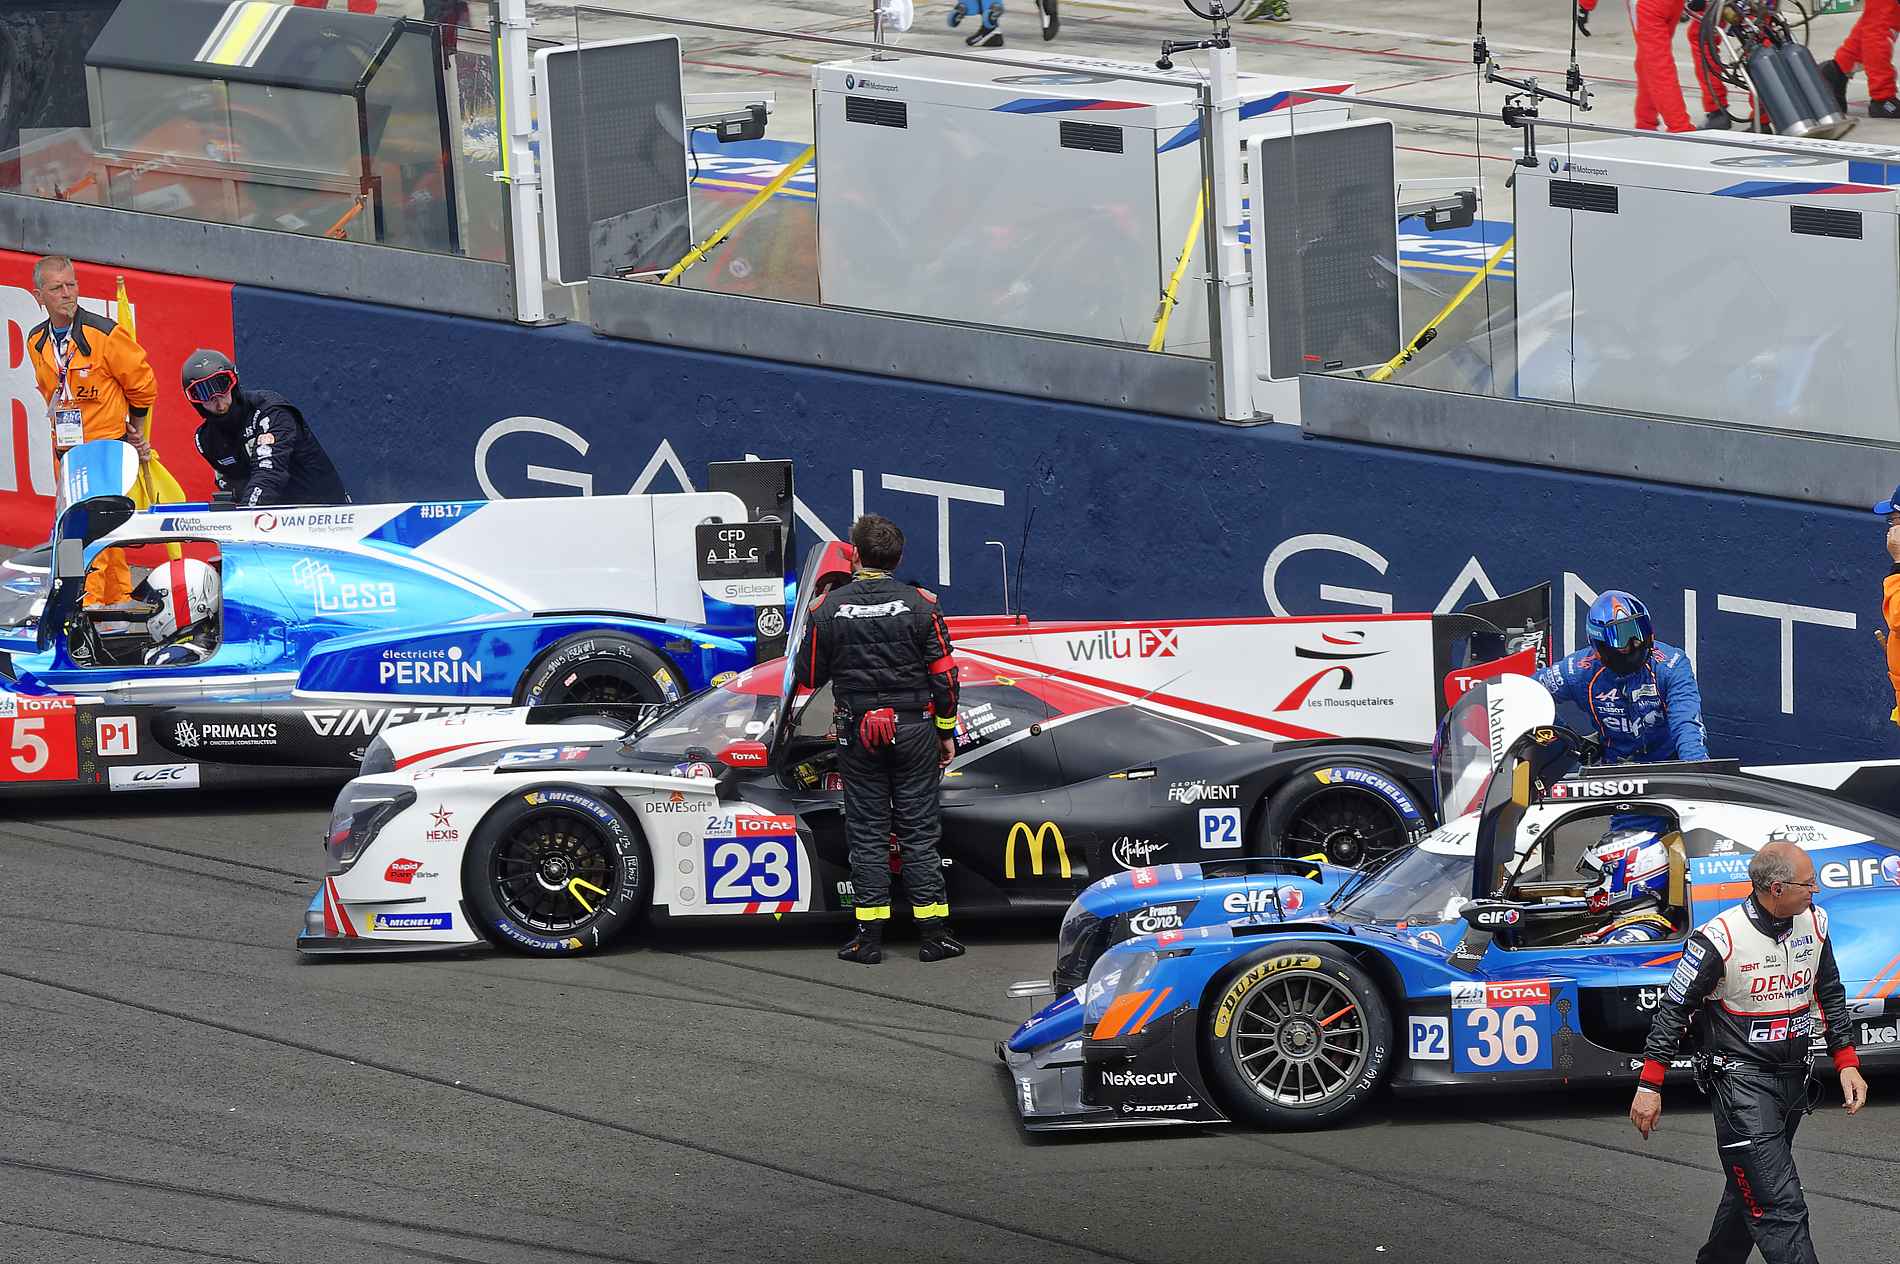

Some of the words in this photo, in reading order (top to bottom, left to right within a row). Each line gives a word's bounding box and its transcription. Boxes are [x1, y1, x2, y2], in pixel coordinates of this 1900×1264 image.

[870, 81, 899, 92] Motorsport
[1576, 165, 1609, 177] Motorsport
[420, 504, 463, 519] #JB17
[180, 517, 201, 526] Auto
[180, 523, 233, 532] Windscreens
[281, 514, 307, 528] VAN
[308, 513, 331, 527] DER
[334, 513, 355, 525] LEE
[718, 529, 746, 541] CFD
[725, 583, 777, 598] Silclear
[1139, 628, 1178, 658] FX
[382, 649, 445, 660] électricité
[379, 660, 482, 685] PERRIN
[22, 699, 73, 711] TOTAL
[1324, 696, 1395, 709] Mousquetaires
[100, 723, 130, 751] P1
[202, 723, 278, 739] PRIMALYS
[10, 718, 50, 774] 5
[730, 752, 762, 761] TOTAL
[132, 766, 188, 782] WEC
[1170, 779, 1207, 787] GROUPE
[1567, 779, 1649, 798] TISSOT
[1345, 769, 1415, 814] MICHELIN
[549, 791, 608, 818] MICHELIN
[738, 818, 797, 831] TOTAL
[1203, 815, 1237, 843] P2
[1785, 823, 1817, 832] France
[426, 829, 459, 840] HEXIS
[391, 863, 418, 871] Rapid
[712, 841, 792, 899] 23
[1819, 858, 1881, 889] elf
[1223, 889, 1275, 913] elf
[1149, 906, 1177, 918] France
[1477, 913, 1505, 924] elf
[389, 917, 443, 927] MICHELIN
[499, 922, 558, 950] MICHELIN
[1223, 954, 1312, 1014] DUNLOP
[1750, 967, 1812, 994] DENSO
[1488, 986, 1548, 1000] TOTAL
[1751, 993, 1785, 1002] TOYOTA
[1411, 1023, 1444, 1054] P2
[1466, 1005, 1540, 1067] 36
[1751, 1028, 1786, 1041] GR
[1134, 1102, 1199, 1113] DUNLOP
